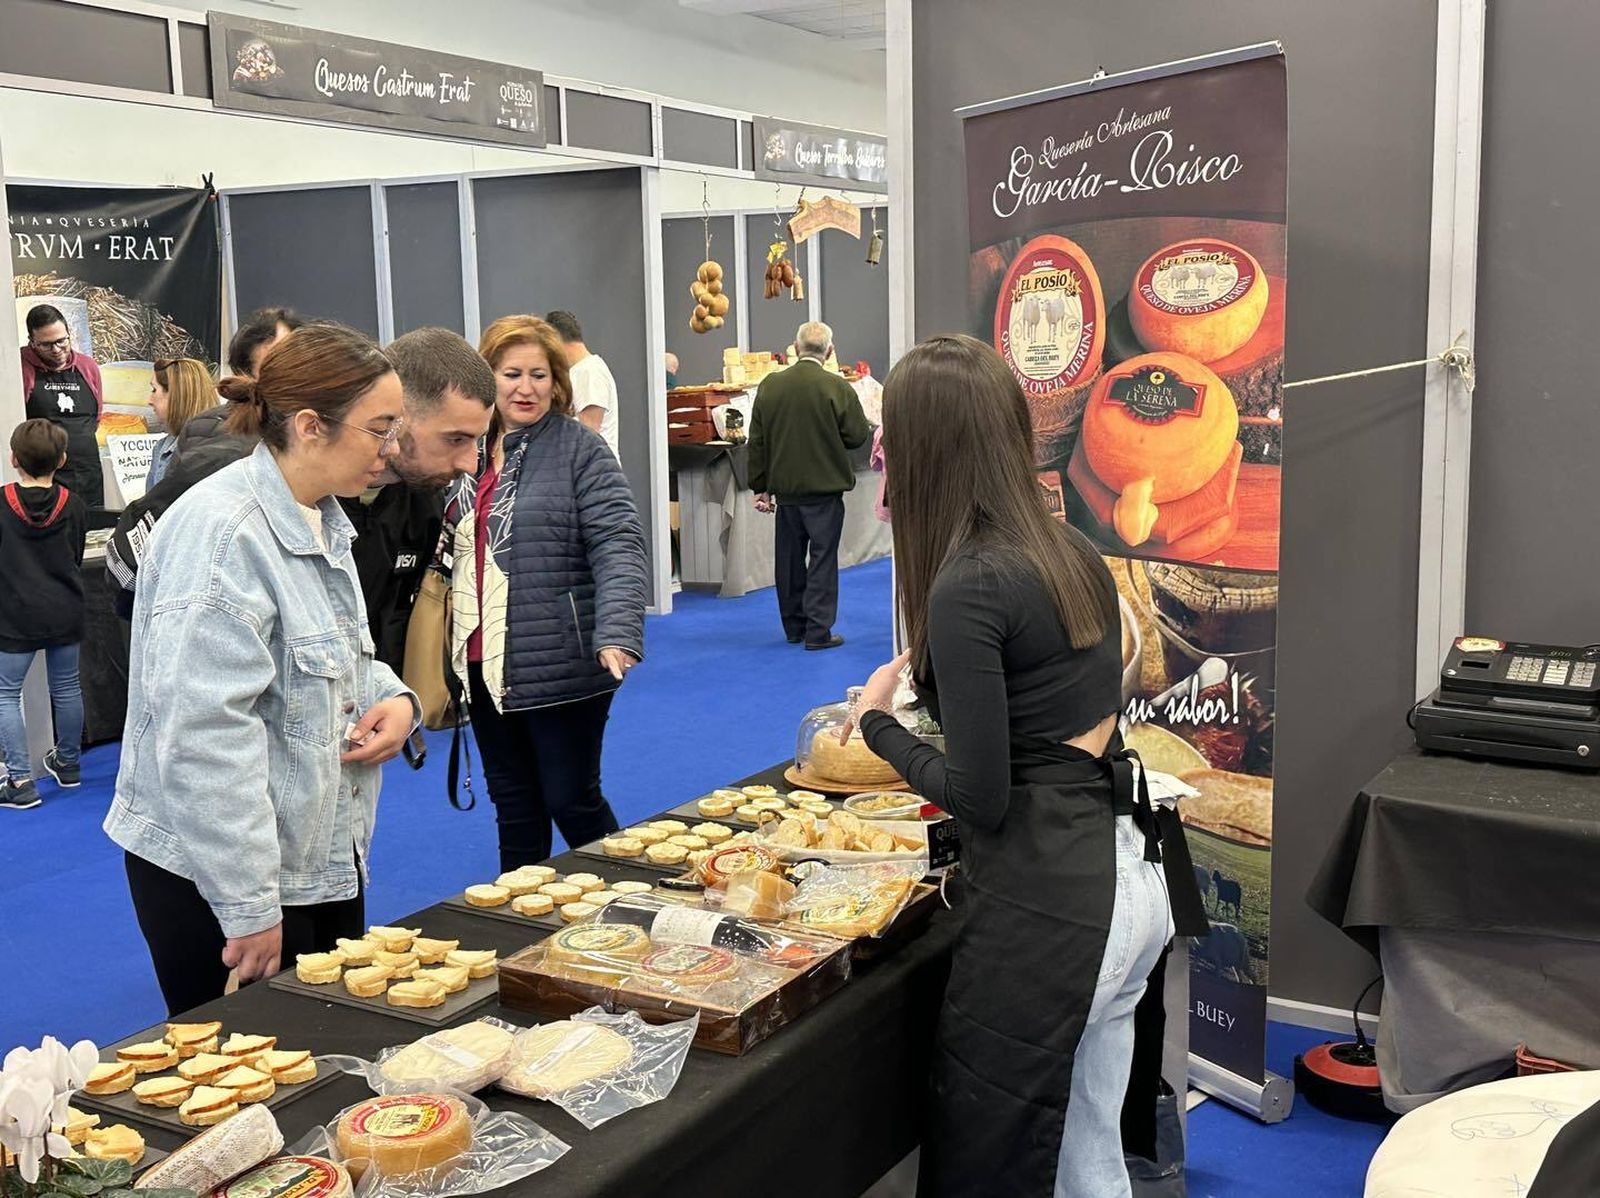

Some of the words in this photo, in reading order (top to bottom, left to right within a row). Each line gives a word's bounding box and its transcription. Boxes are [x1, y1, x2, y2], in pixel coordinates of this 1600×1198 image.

[314, 58, 370, 97] Quesos
[373, 65, 436, 99] Castrum
[438, 73, 475, 104] Erat
[500, 85, 532, 102] QUESO
[9, 232, 84, 259] RVM
[108, 235, 174, 260] ERAT
[1021, 280, 1031, 291] EL
[1178, 304, 1217, 314] OVEJA
[1065, 321, 1095, 382] MERINA
[1125, 697, 1155, 725] su
[1163, 672, 1239, 726] sabor!
[1197, 1001, 1236, 1032] BUEY
